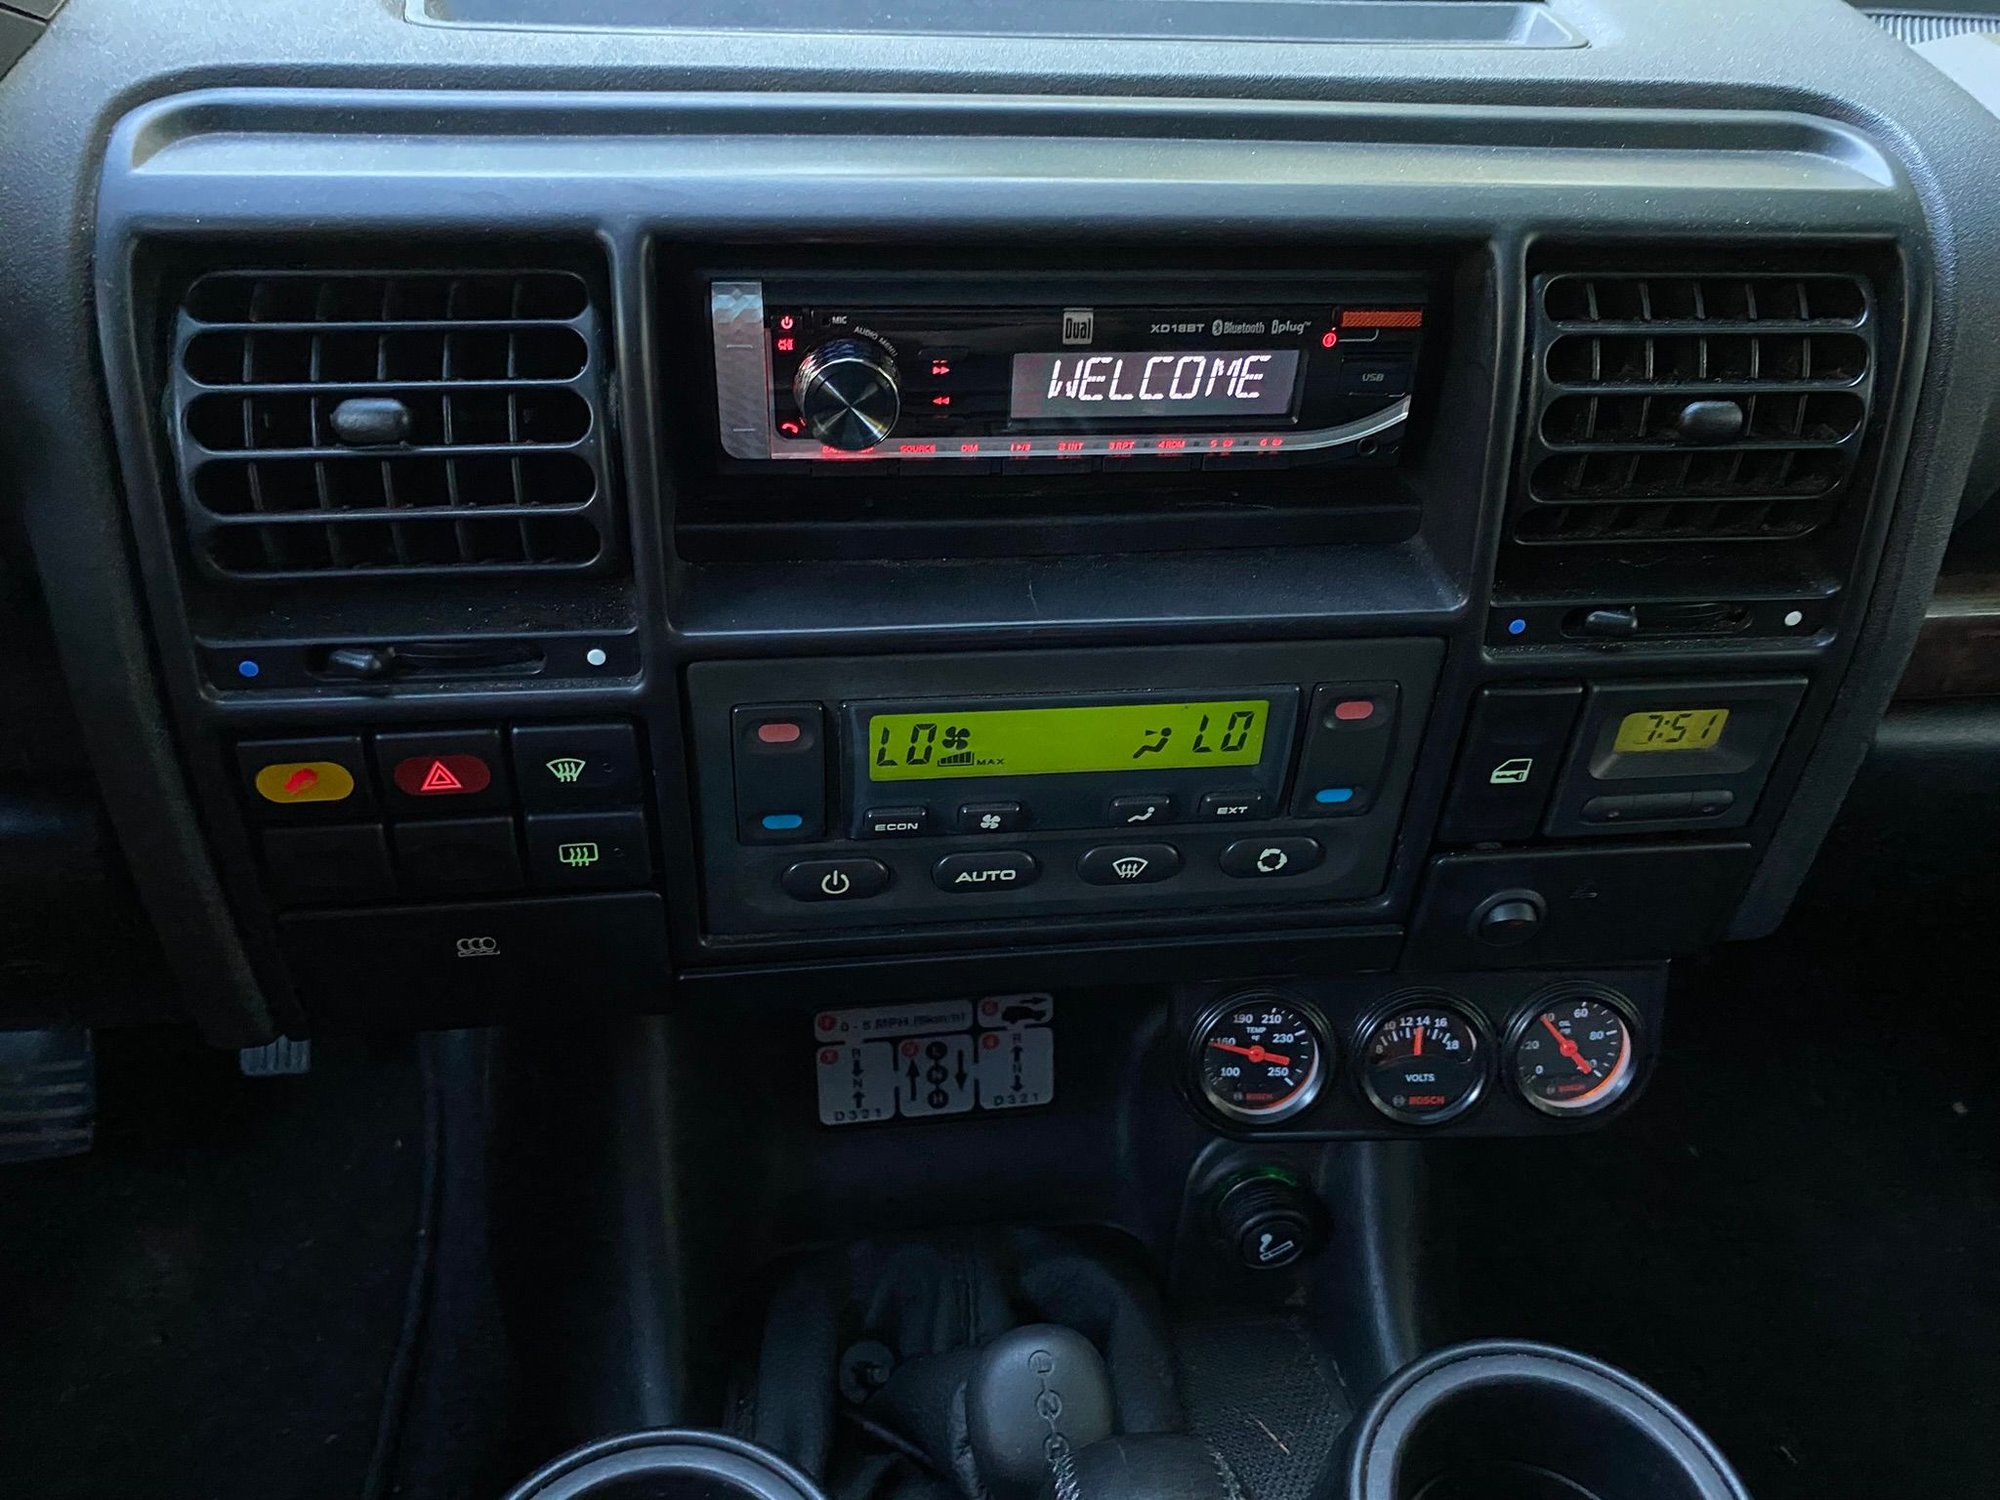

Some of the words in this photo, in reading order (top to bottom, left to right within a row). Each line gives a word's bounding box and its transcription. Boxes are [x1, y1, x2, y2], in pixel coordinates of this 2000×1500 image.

[832, 315, 847, 325] MIC
[1065, 317, 1092, 339] Dual
[1150, 322, 1205, 334] XD18BT
[1223, 320, 1265, 334] Bluetooth
[853, 326, 879, 340] AUDIO
[1048, 355, 1271, 400] WELCOME
[1361, 373, 1385, 382] USB
[900, 444, 936, 454] SOURCE
[961, 444, 979, 453] DIM
[1648, 713, 1718, 743] 7:51
[976, 758, 1005, 766] MAX
[1216, 806, 1248, 815] EXT
[874, 822, 919, 832] ECON
[954, 869, 1017, 884] AUTO
[1573, 1007, 1589, 1018] 60
[1233, 1013, 1254, 1024] 190
[1261, 1013, 1282, 1024] 210
[1400, 1016, 1414, 1027] 12
[1416, 1015, 1430, 1026] 14
[1434, 1017, 1448, 1028] 16
[1246, 1026, 1267, 1034] TEMP
[1383, 1020, 1397, 1030] 10
[1272, 1033, 1294, 1044] 230
[1589, 1030, 1605, 1041] 80
[1445, 1039, 1460, 1051] 18
[1525, 1040, 1540, 1050] 20
[1220, 1066, 1241, 1077] 100
[1267, 1066, 1289, 1077] 250
[1535, 1065, 1544, 1075] 0
[1405, 1073, 1436, 1082] VOLTS
[1007, 1095, 1016, 1105] 3
[1019, 1093, 1028, 1103] 2
[1408, 1096, 1446, 1105] BOSCH
